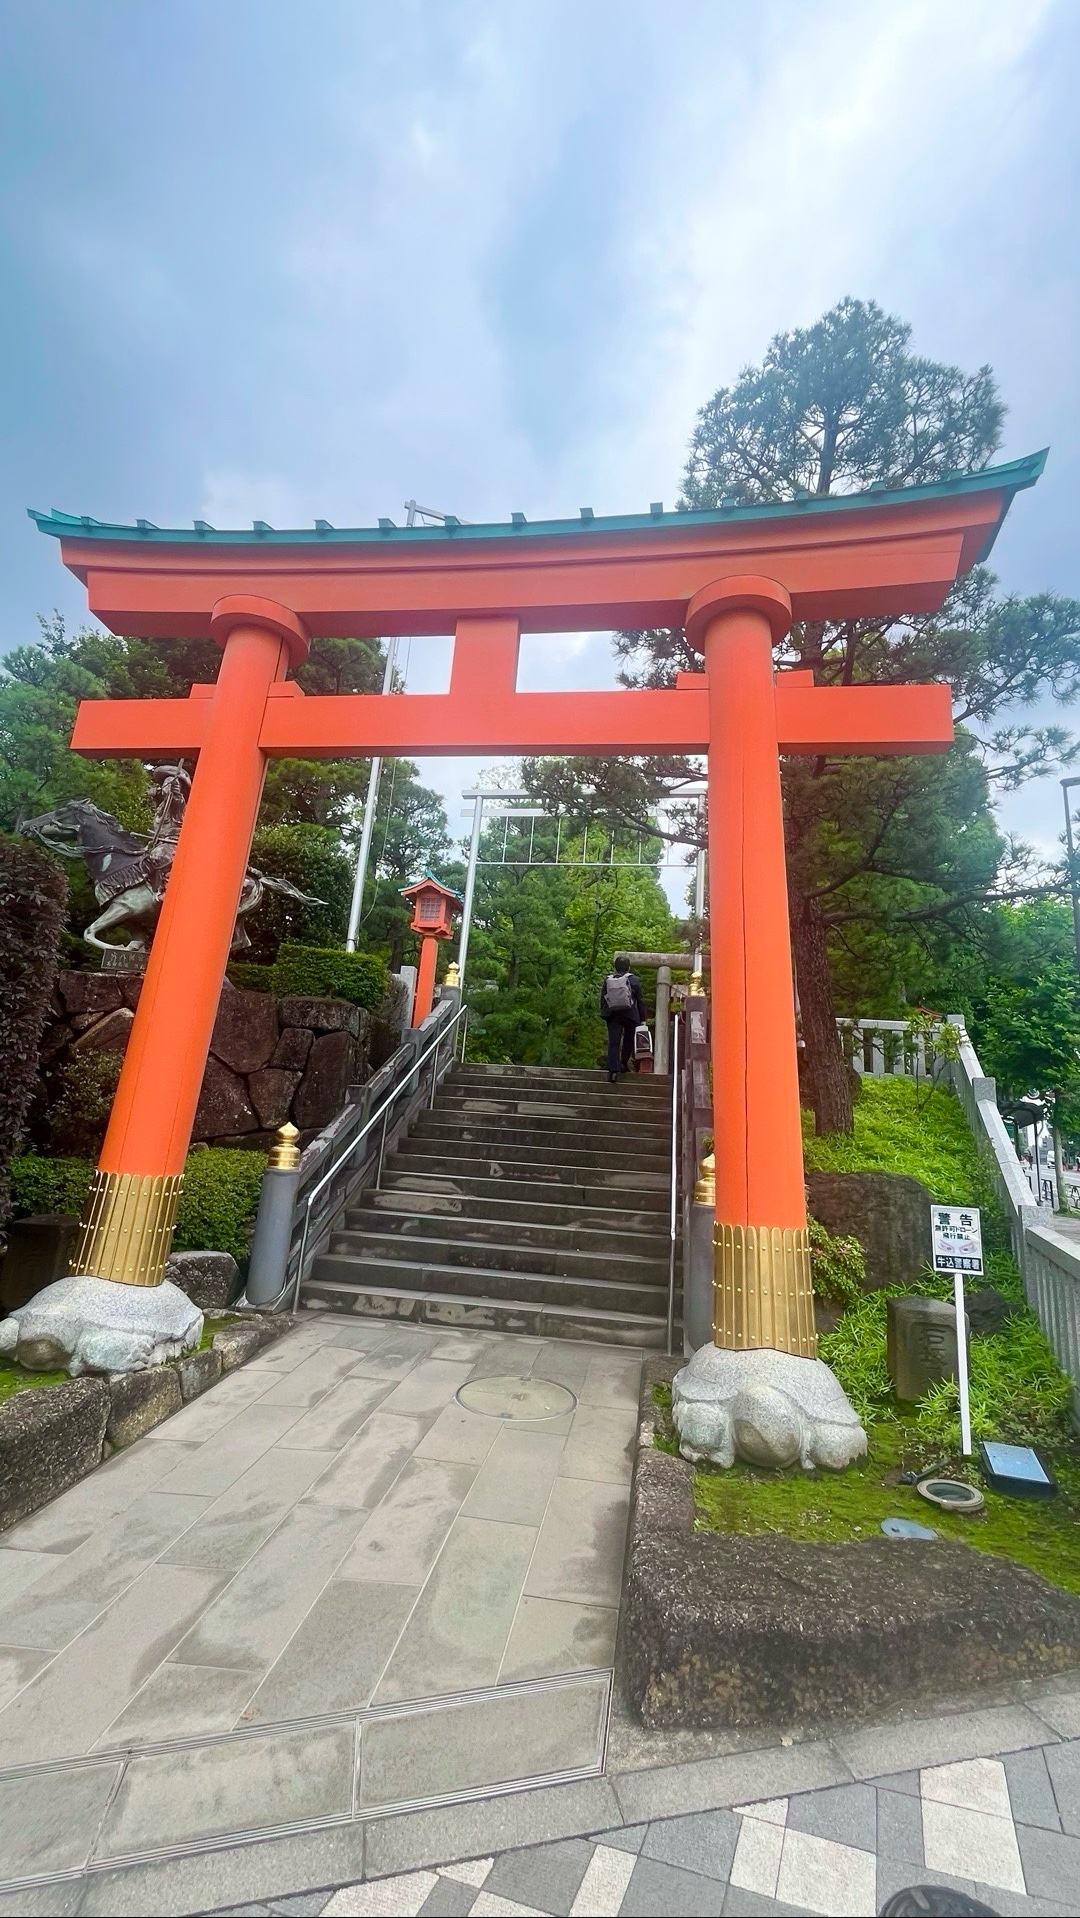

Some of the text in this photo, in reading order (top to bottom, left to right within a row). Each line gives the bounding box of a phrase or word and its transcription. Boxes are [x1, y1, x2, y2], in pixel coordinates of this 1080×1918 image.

[938, 1212, 973, 1227] 警告
[935, 1225, 978, 1234] 無許可ドローン
[937, 1256, 980, 1270] 牛込警察署
